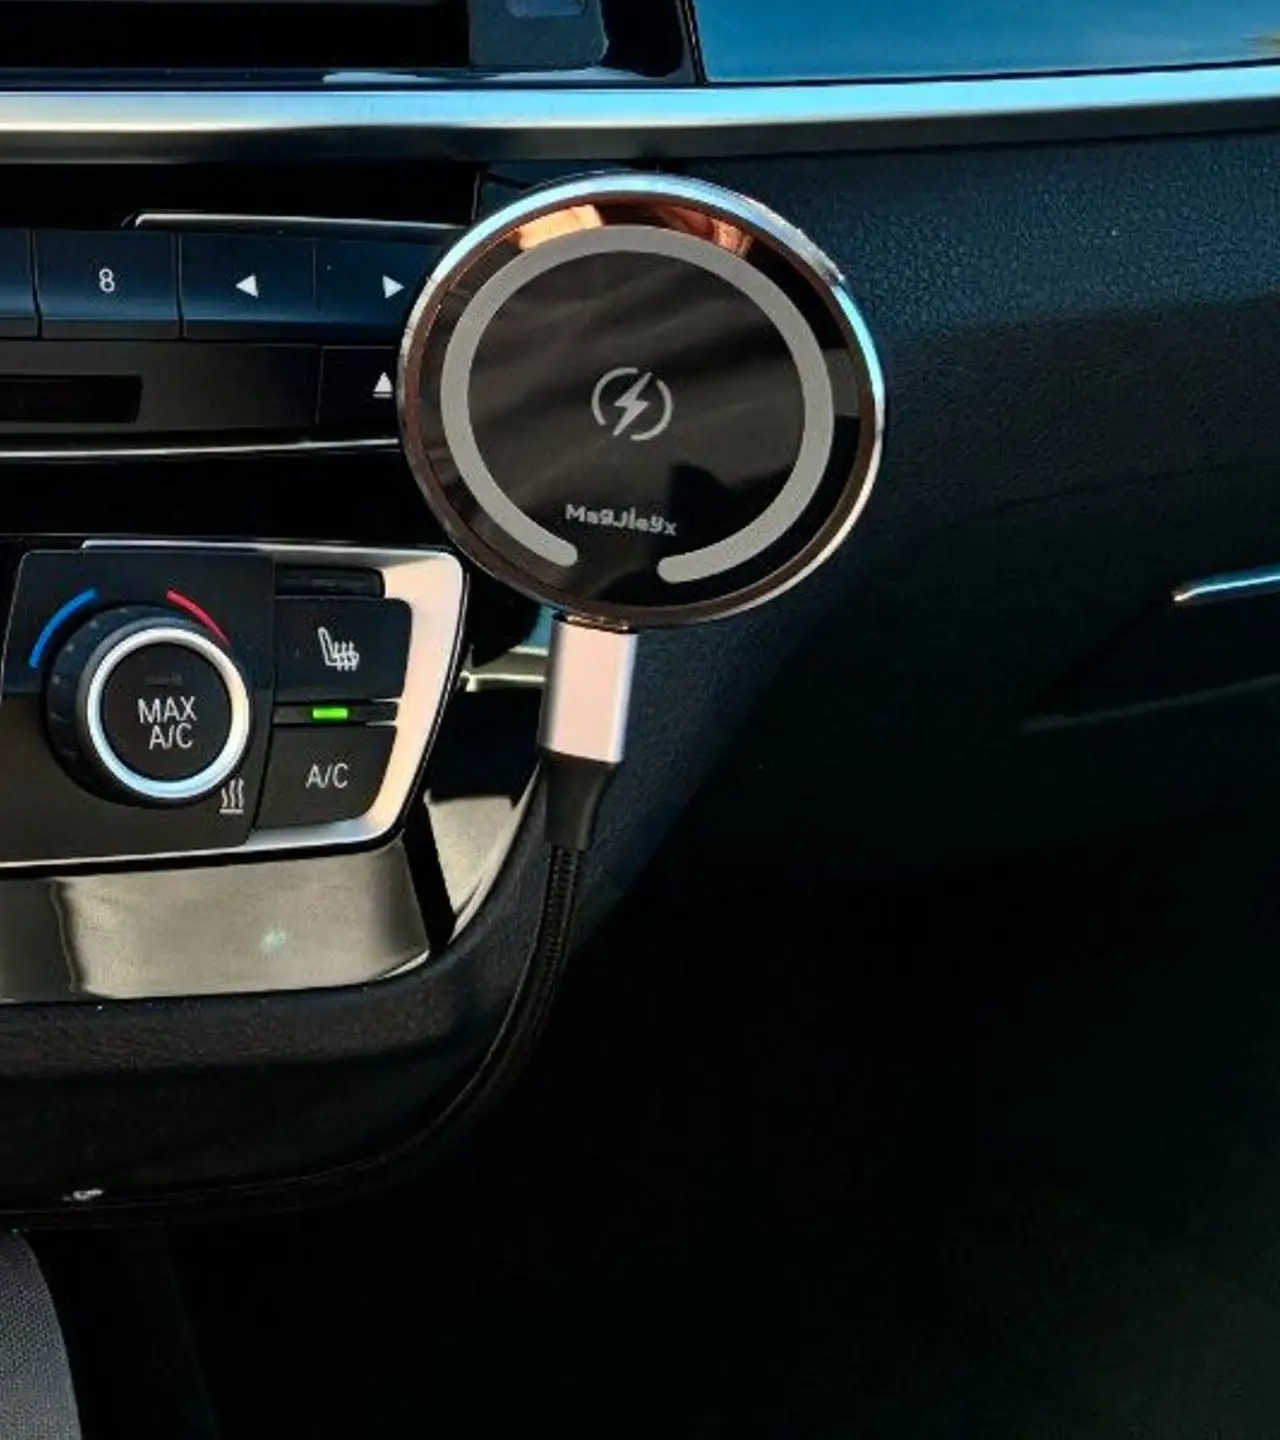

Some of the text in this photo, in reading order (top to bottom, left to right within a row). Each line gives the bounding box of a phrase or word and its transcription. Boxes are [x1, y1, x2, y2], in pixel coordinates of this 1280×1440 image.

[98, 268, 116, 293] 8
[138, 697, 198, 724] MAX
[148, 722, 194, 750] A/C
[306, 763, 349, 790] A/C
